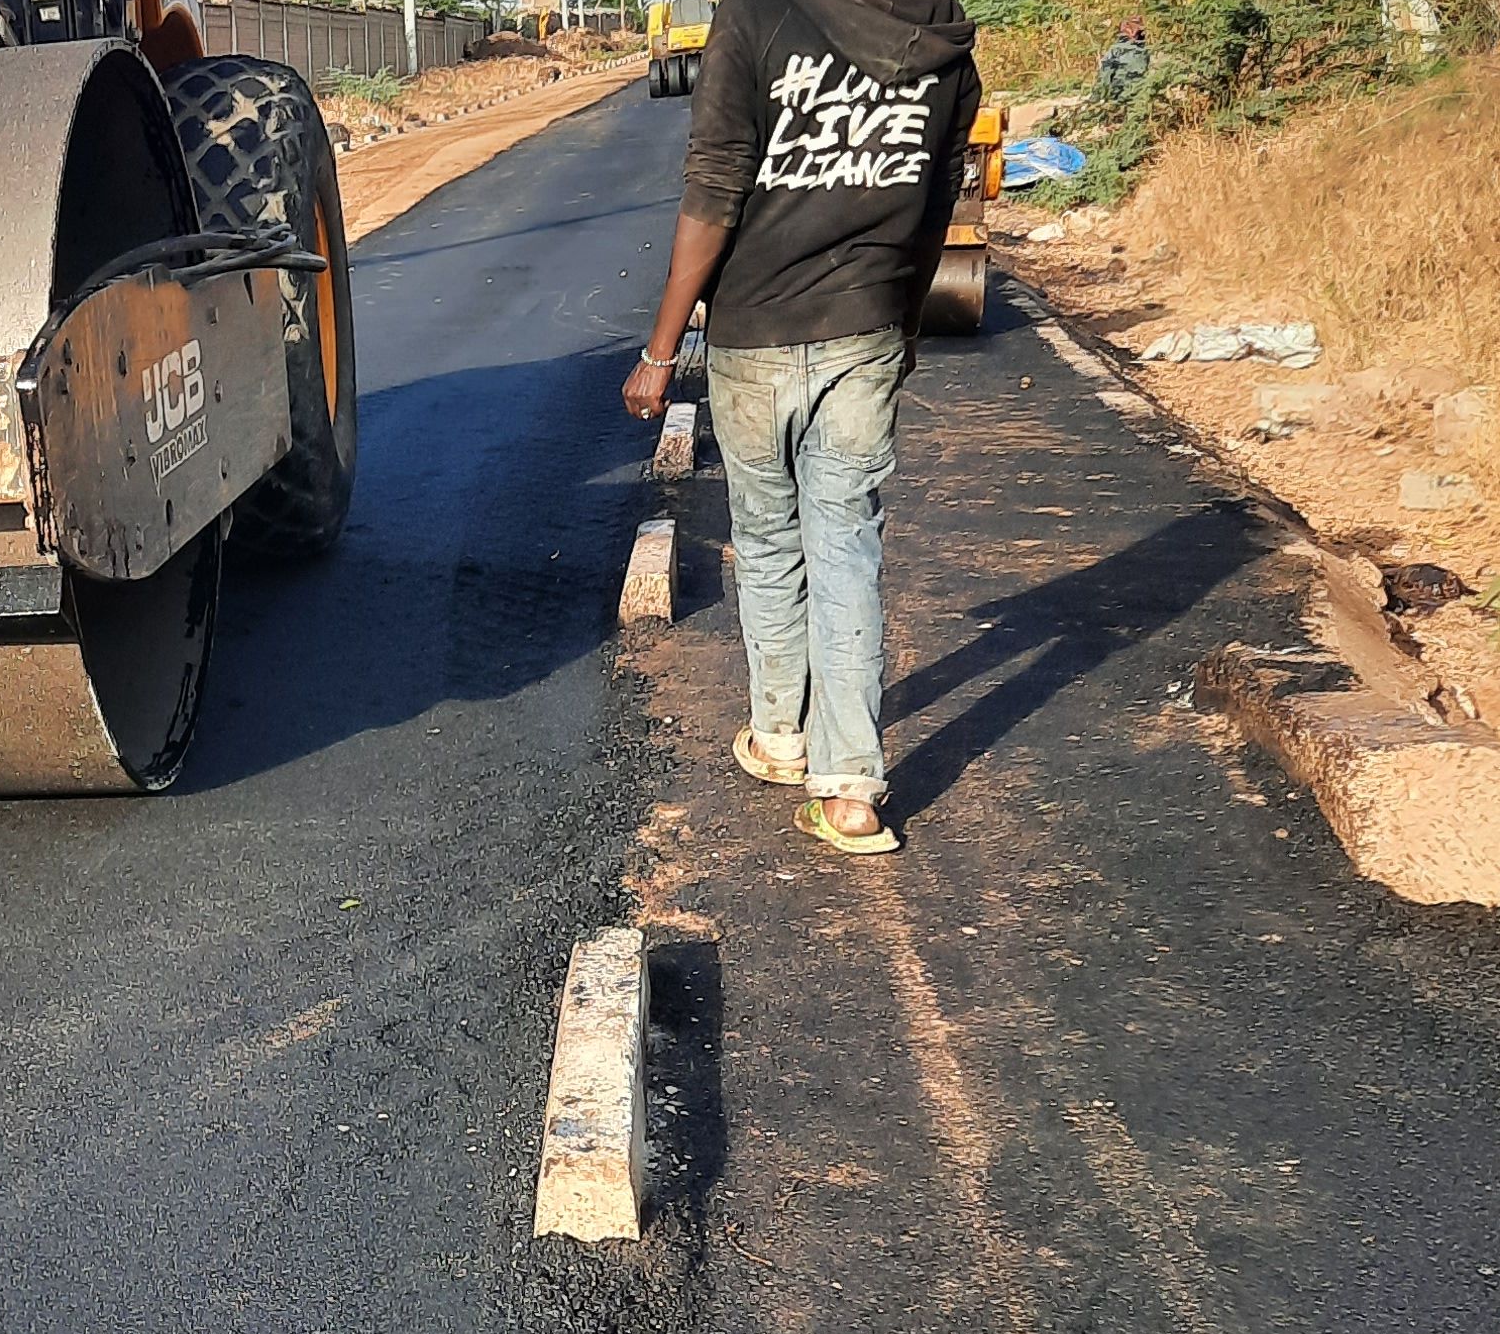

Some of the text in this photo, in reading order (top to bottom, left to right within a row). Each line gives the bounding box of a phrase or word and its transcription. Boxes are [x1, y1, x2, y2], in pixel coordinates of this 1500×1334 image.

[766, 104, 931, 156] LIVE
[755, 151, 931, 190] ALLIANCE
[141, 339, 205, 443] JCB
[150, 413, 209, 497] VIBROMAX
